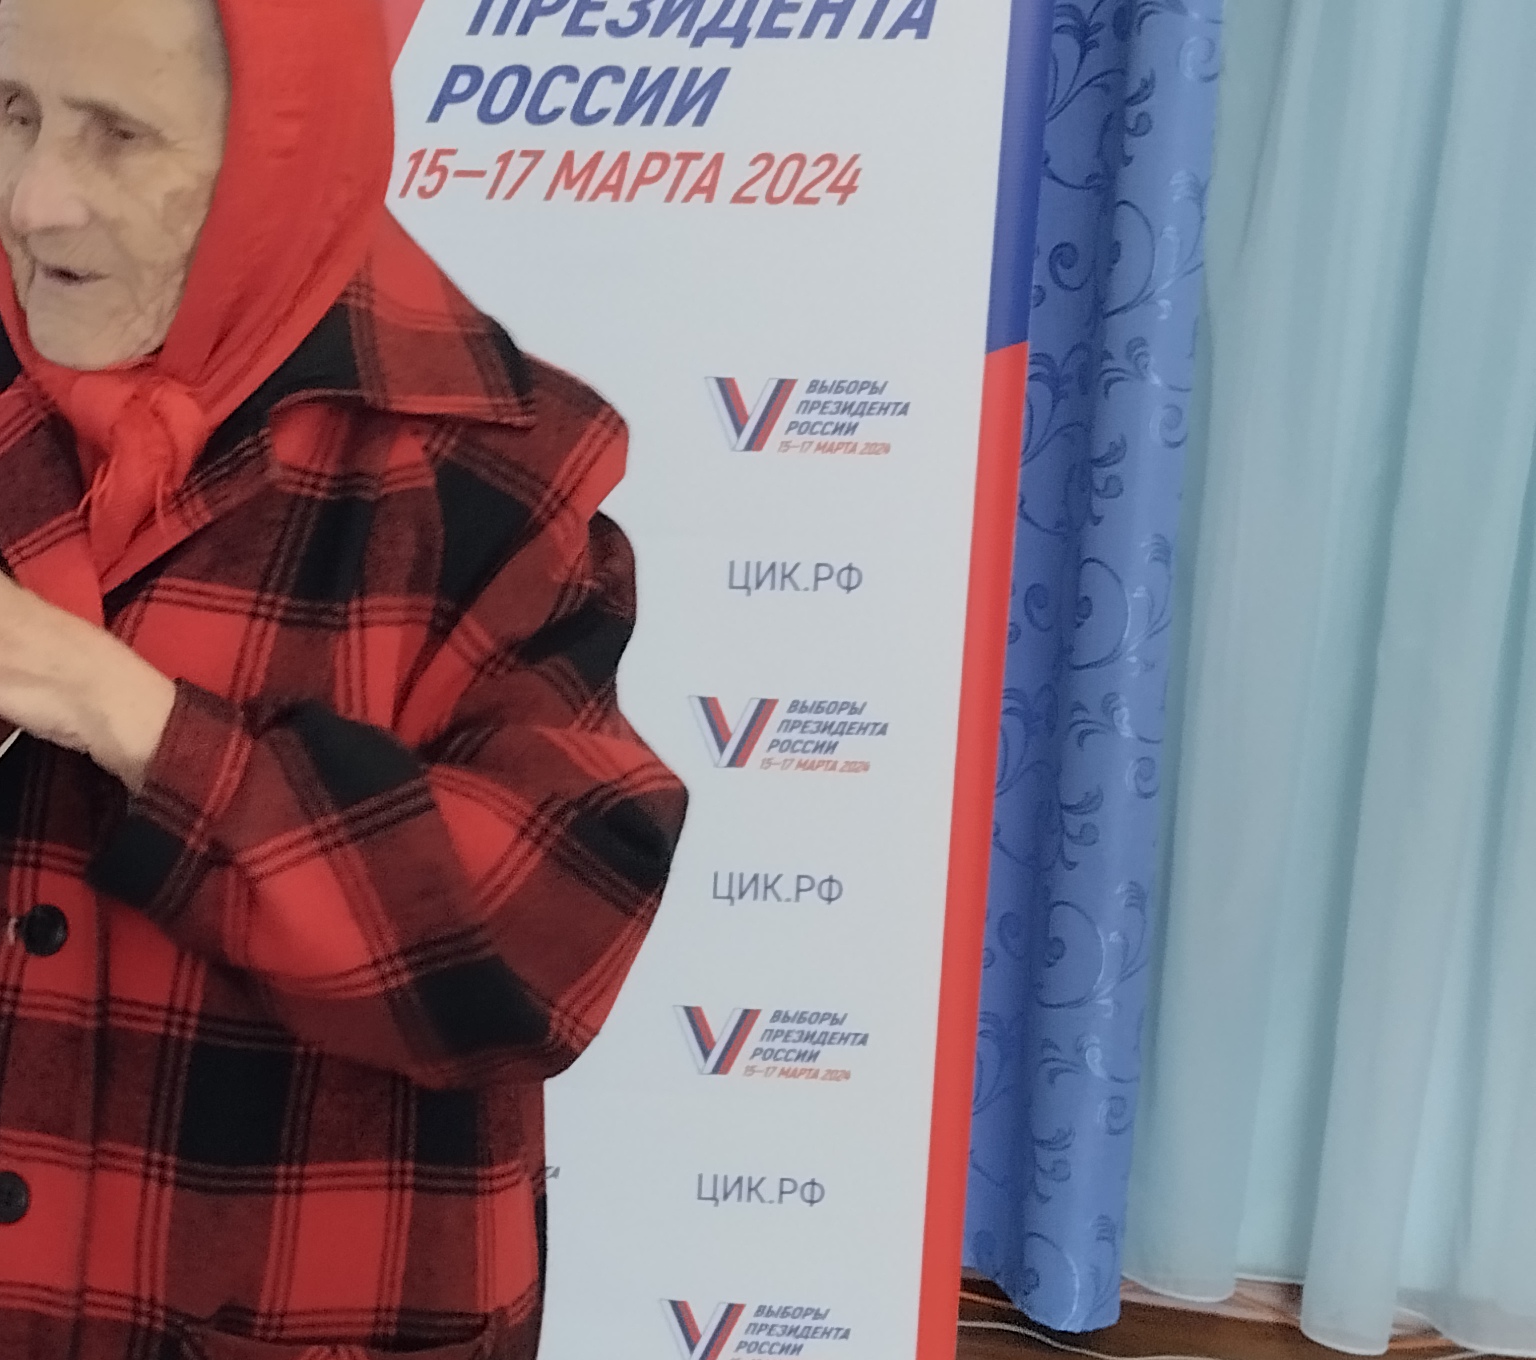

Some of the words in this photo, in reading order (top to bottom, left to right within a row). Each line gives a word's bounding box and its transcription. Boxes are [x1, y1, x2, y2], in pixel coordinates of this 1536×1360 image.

[426, 65, 732, 127] РОССИИ
[544, 150, 726, 204] МАРТА
[729, 152, 862, 206] 2024
[805, 380, 889, 396] ВЫБОРЫ
[795, 400, 911, 418] ПРЕЗИДЕНТА
[784, 421, 859, 436] РОССИИ
[728, 560, 863, 596] ЦИК.РФ
[786, 700, 867, 715] ВЫБОРЫ
[777, 719, 889, 737] ПРЕЗИДЕНТА
[766, 739, 839, 755] РОССИИ
[712, 871, 844, 906] ЦИК.РФ
[769, 1010, 848, 1026] ВЫБОРЫ
[759, 1029, 870, 1047] ПРЕЗИДЕНТА
[749, 1048, 821, 1063] РОССИИ
[697, 1173, 826, 1207] ЦИК.РФ
[754, 1304, 831, 1321] ВЫБОРЫ
[744, 1322, 852, 1340] ПРЕЗИДЕНТА
[734, 1341, 804, 1356] РОССИИ
